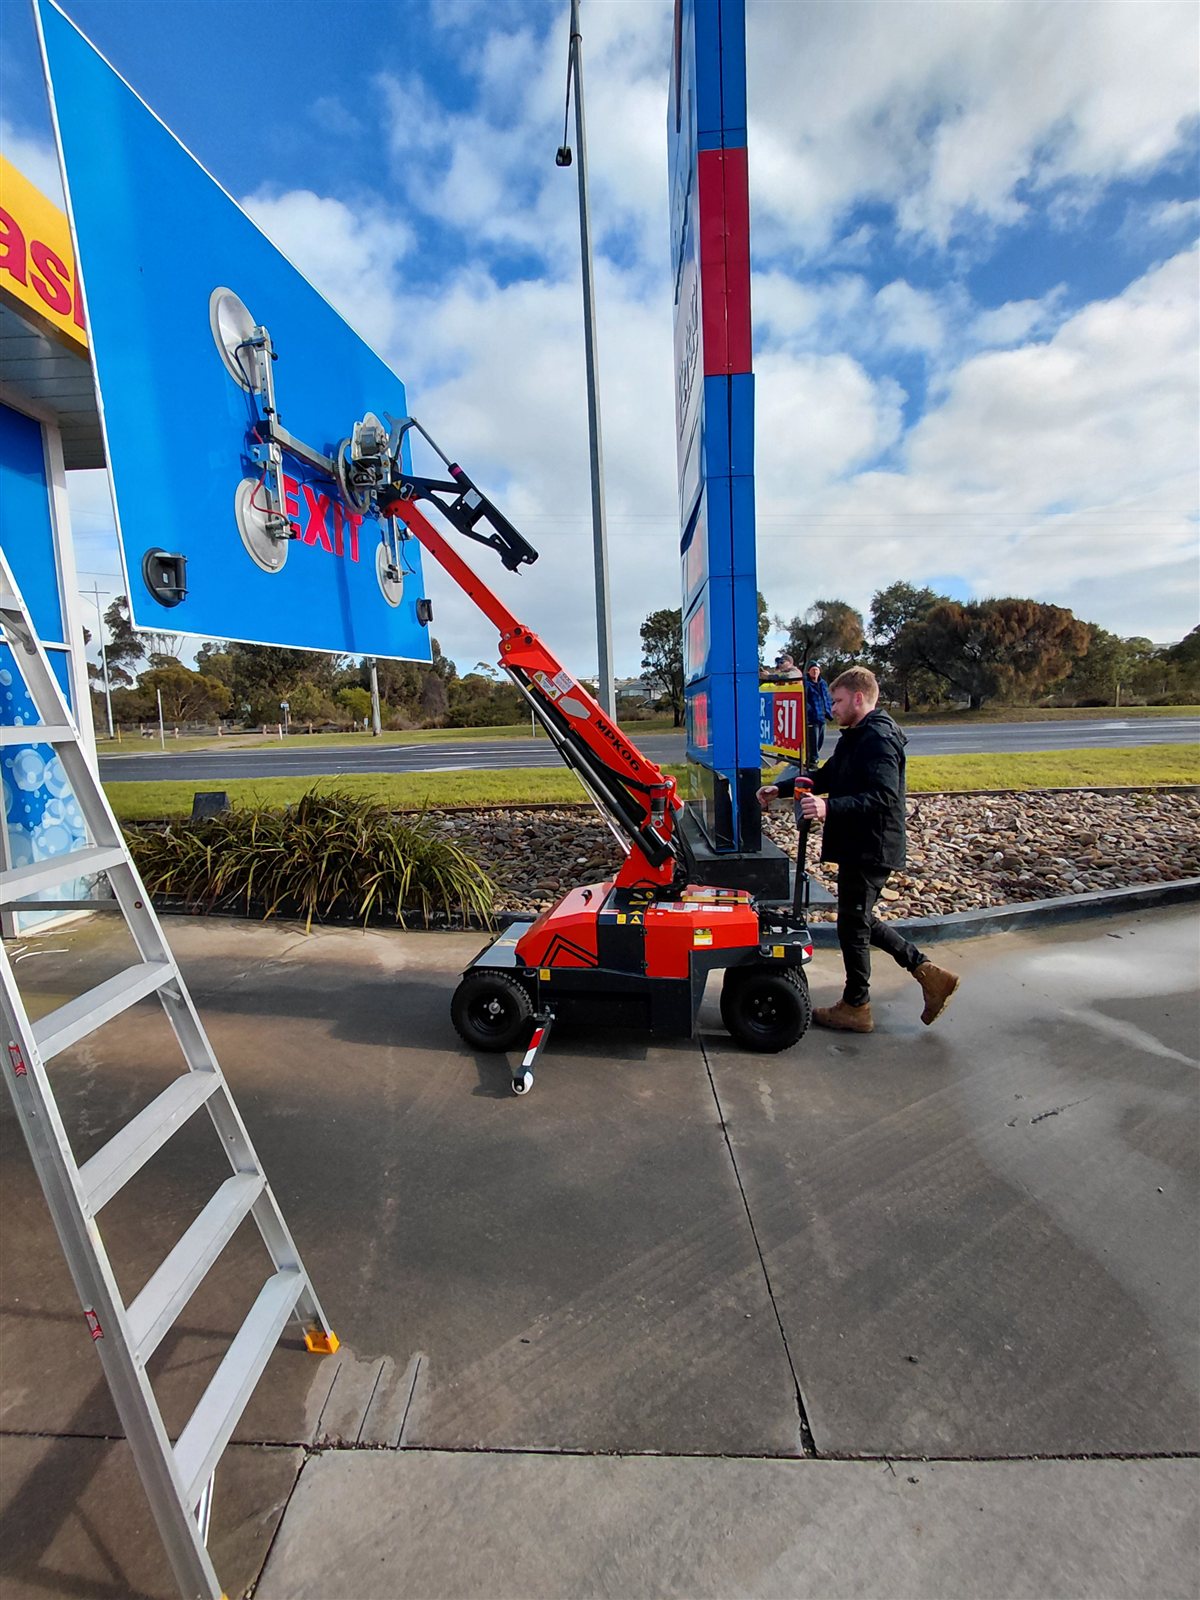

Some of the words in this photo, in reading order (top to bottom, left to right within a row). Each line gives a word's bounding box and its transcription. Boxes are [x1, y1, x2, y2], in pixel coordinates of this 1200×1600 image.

[282, 473, 363, 563] EXIT
[595, 719, 641, 772] MPK06
[777, 699, 797, 739] $11
